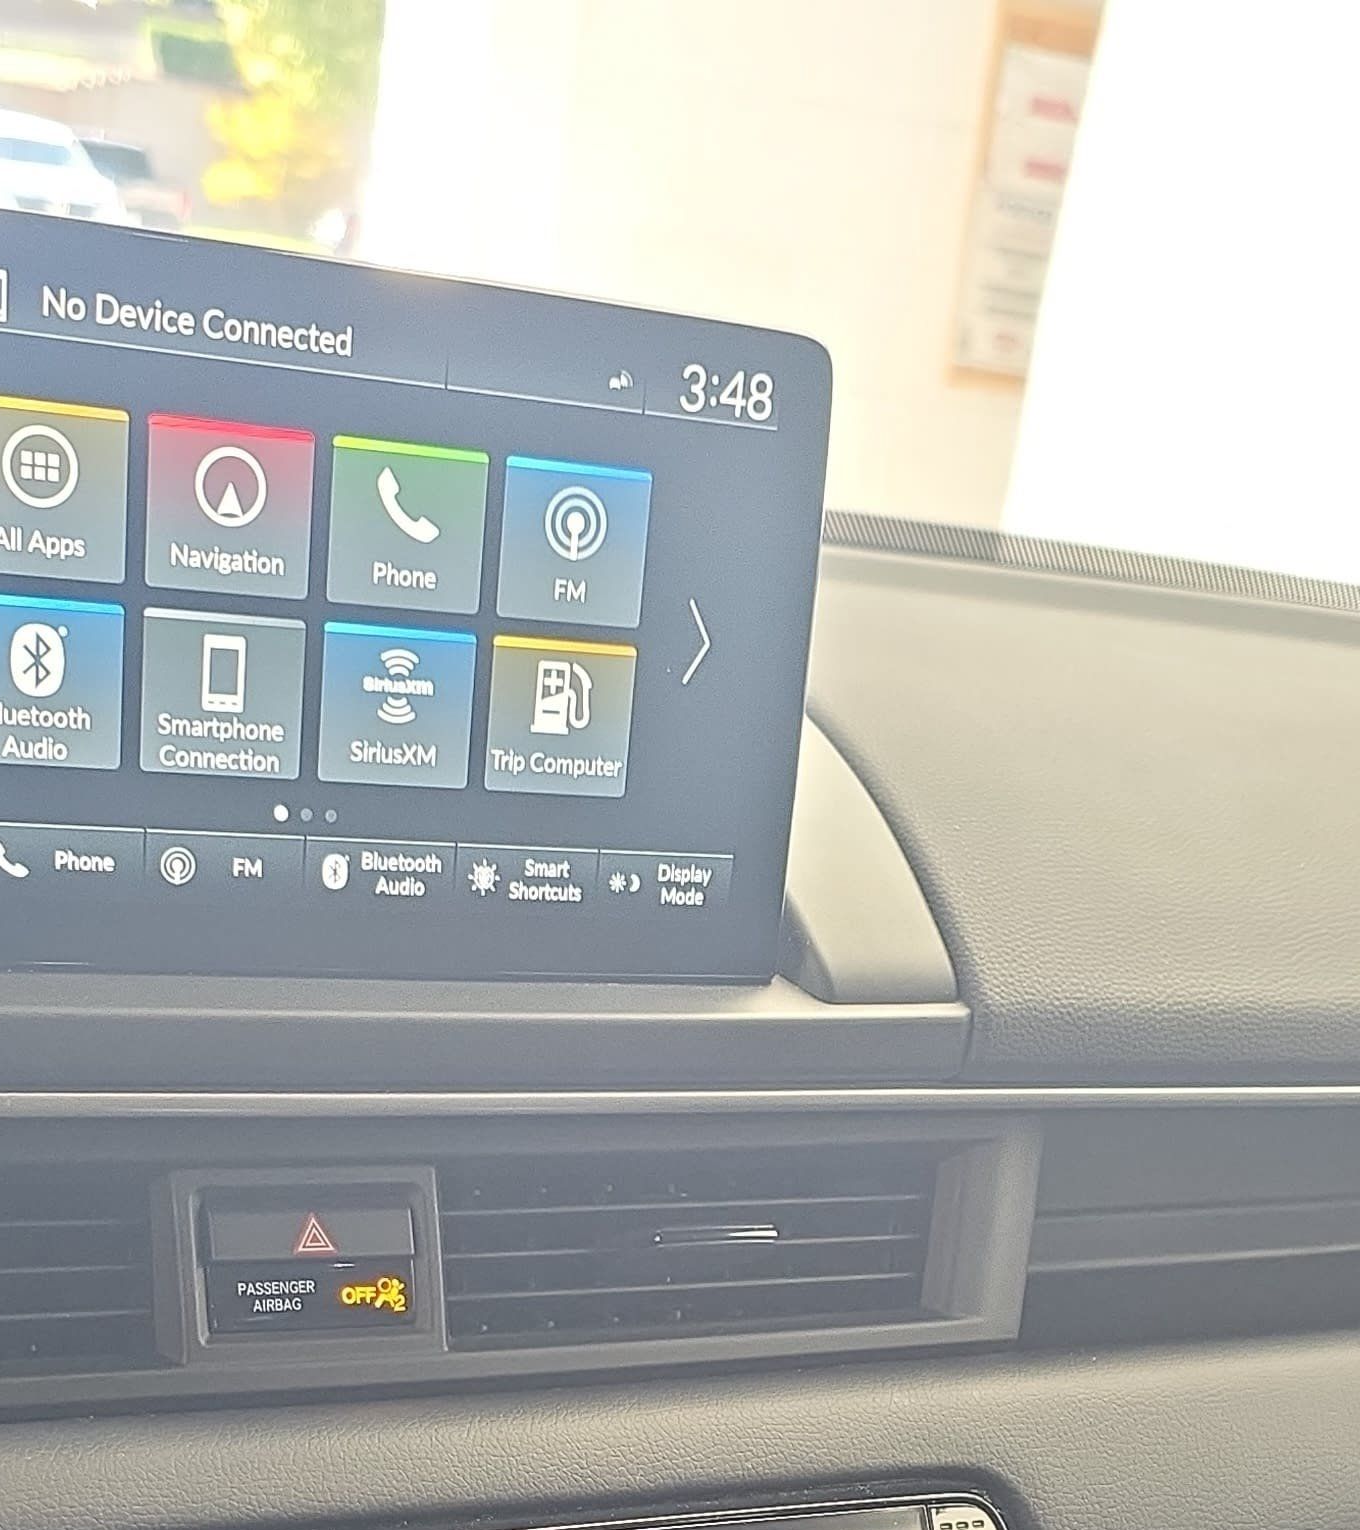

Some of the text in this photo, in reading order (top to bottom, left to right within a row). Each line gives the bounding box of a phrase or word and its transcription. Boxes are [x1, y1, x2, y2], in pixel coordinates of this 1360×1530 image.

[40, 286, 354, 358] No Device Connected
[679, 363, 775, 421] 3:48
[26, 529, 87, 560] Apps
[170, 543, 285, 577] Navigation
[372, 560, 438, 590] Phone
[554, 579, 587, 603] FM
[157, 713, 286, 744] Smartphone
[1, 735, 69, 762] Audio
[159, 745, 280, 774] Connection
[350, 740, 437, 767] SiriusXM
[491, 747, 623, 779] Trip Computer
[54, 850, 116, 873] Phone
[233, 857, 263, 879] FM
[360, 851, 442, 875] Bluetooth
[524, 859, 570, 881] Smart
[376, 876, 425, 898] Audio
[657, 864, 712, 888] Display
[508, 881, 583, 903] Shortcuts
[660, 886, 705, 906] Mode
[237, 1280, 316, 1297] PASSENGER
[341, 1286, 377, 1305] OFF
[253, 1298, 302, 1313] AIRBAG
